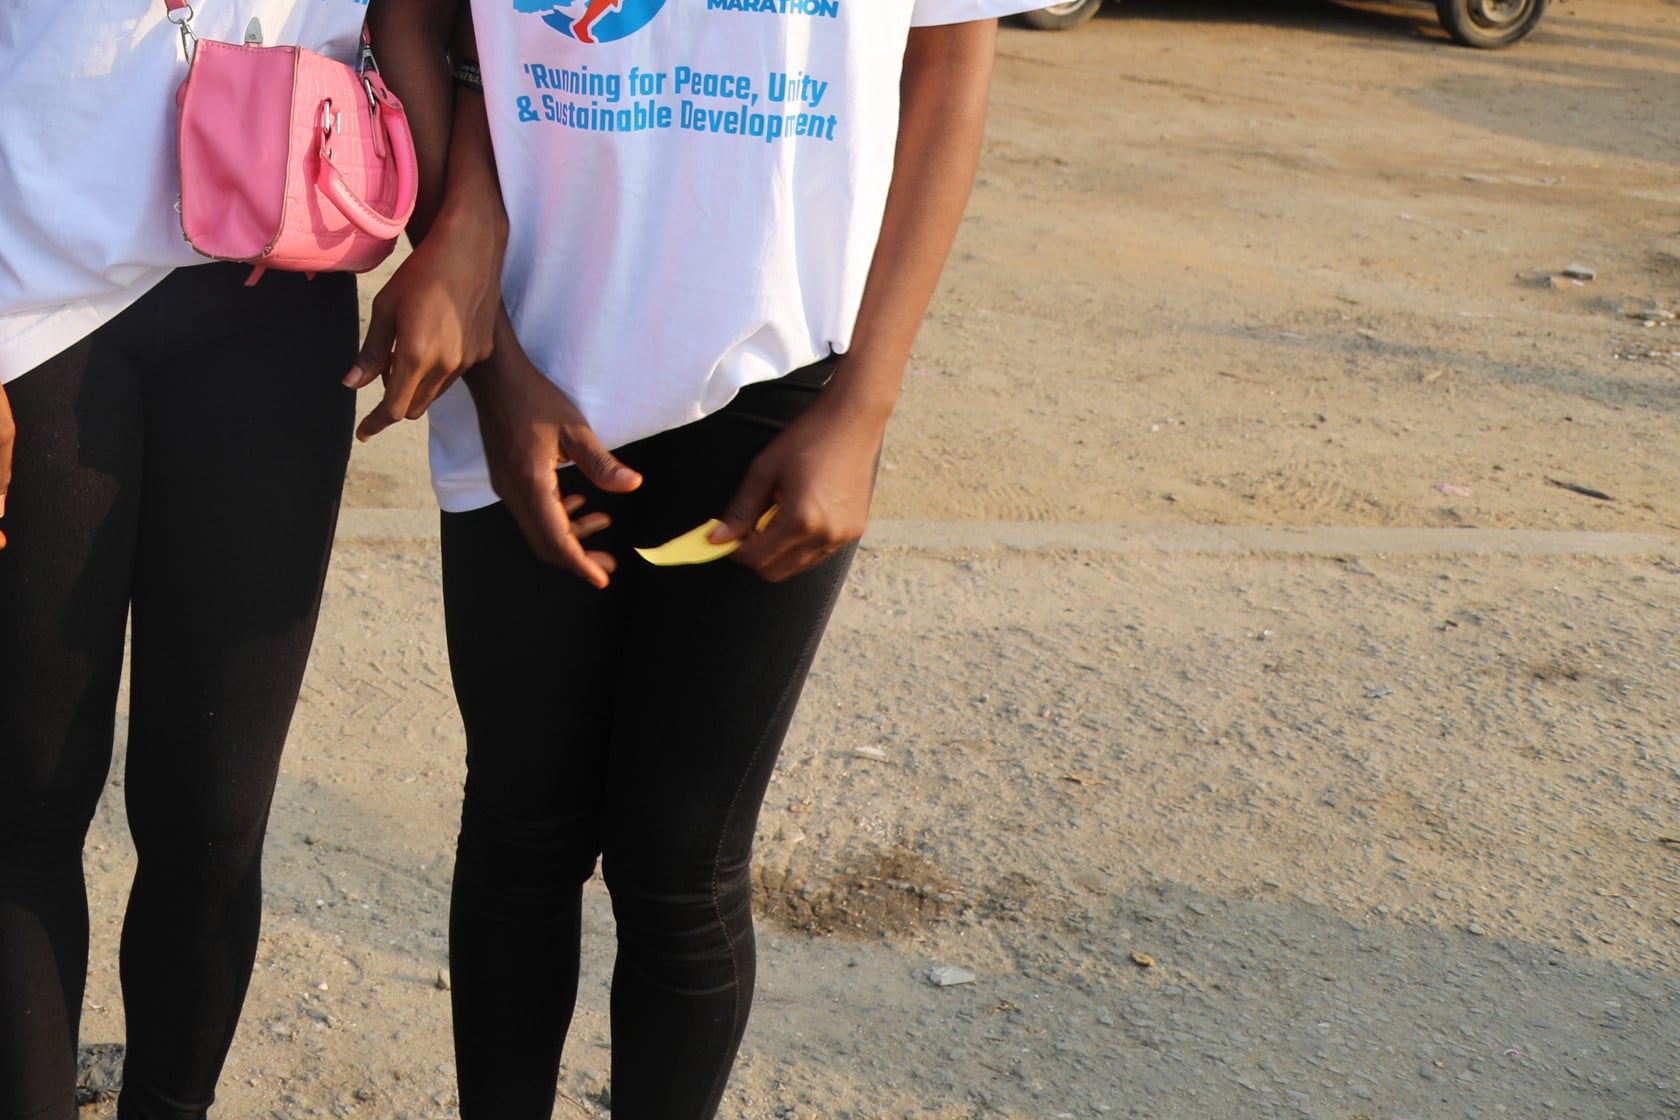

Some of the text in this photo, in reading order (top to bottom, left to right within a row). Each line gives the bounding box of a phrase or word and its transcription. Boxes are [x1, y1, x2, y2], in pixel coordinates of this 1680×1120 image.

[629, 66, 667, 97] for
[674, 66, 759, 107] Peace,
[768, 70, 829, 108] Unity
[516, 93, 838, 143] & Sustainable Development
